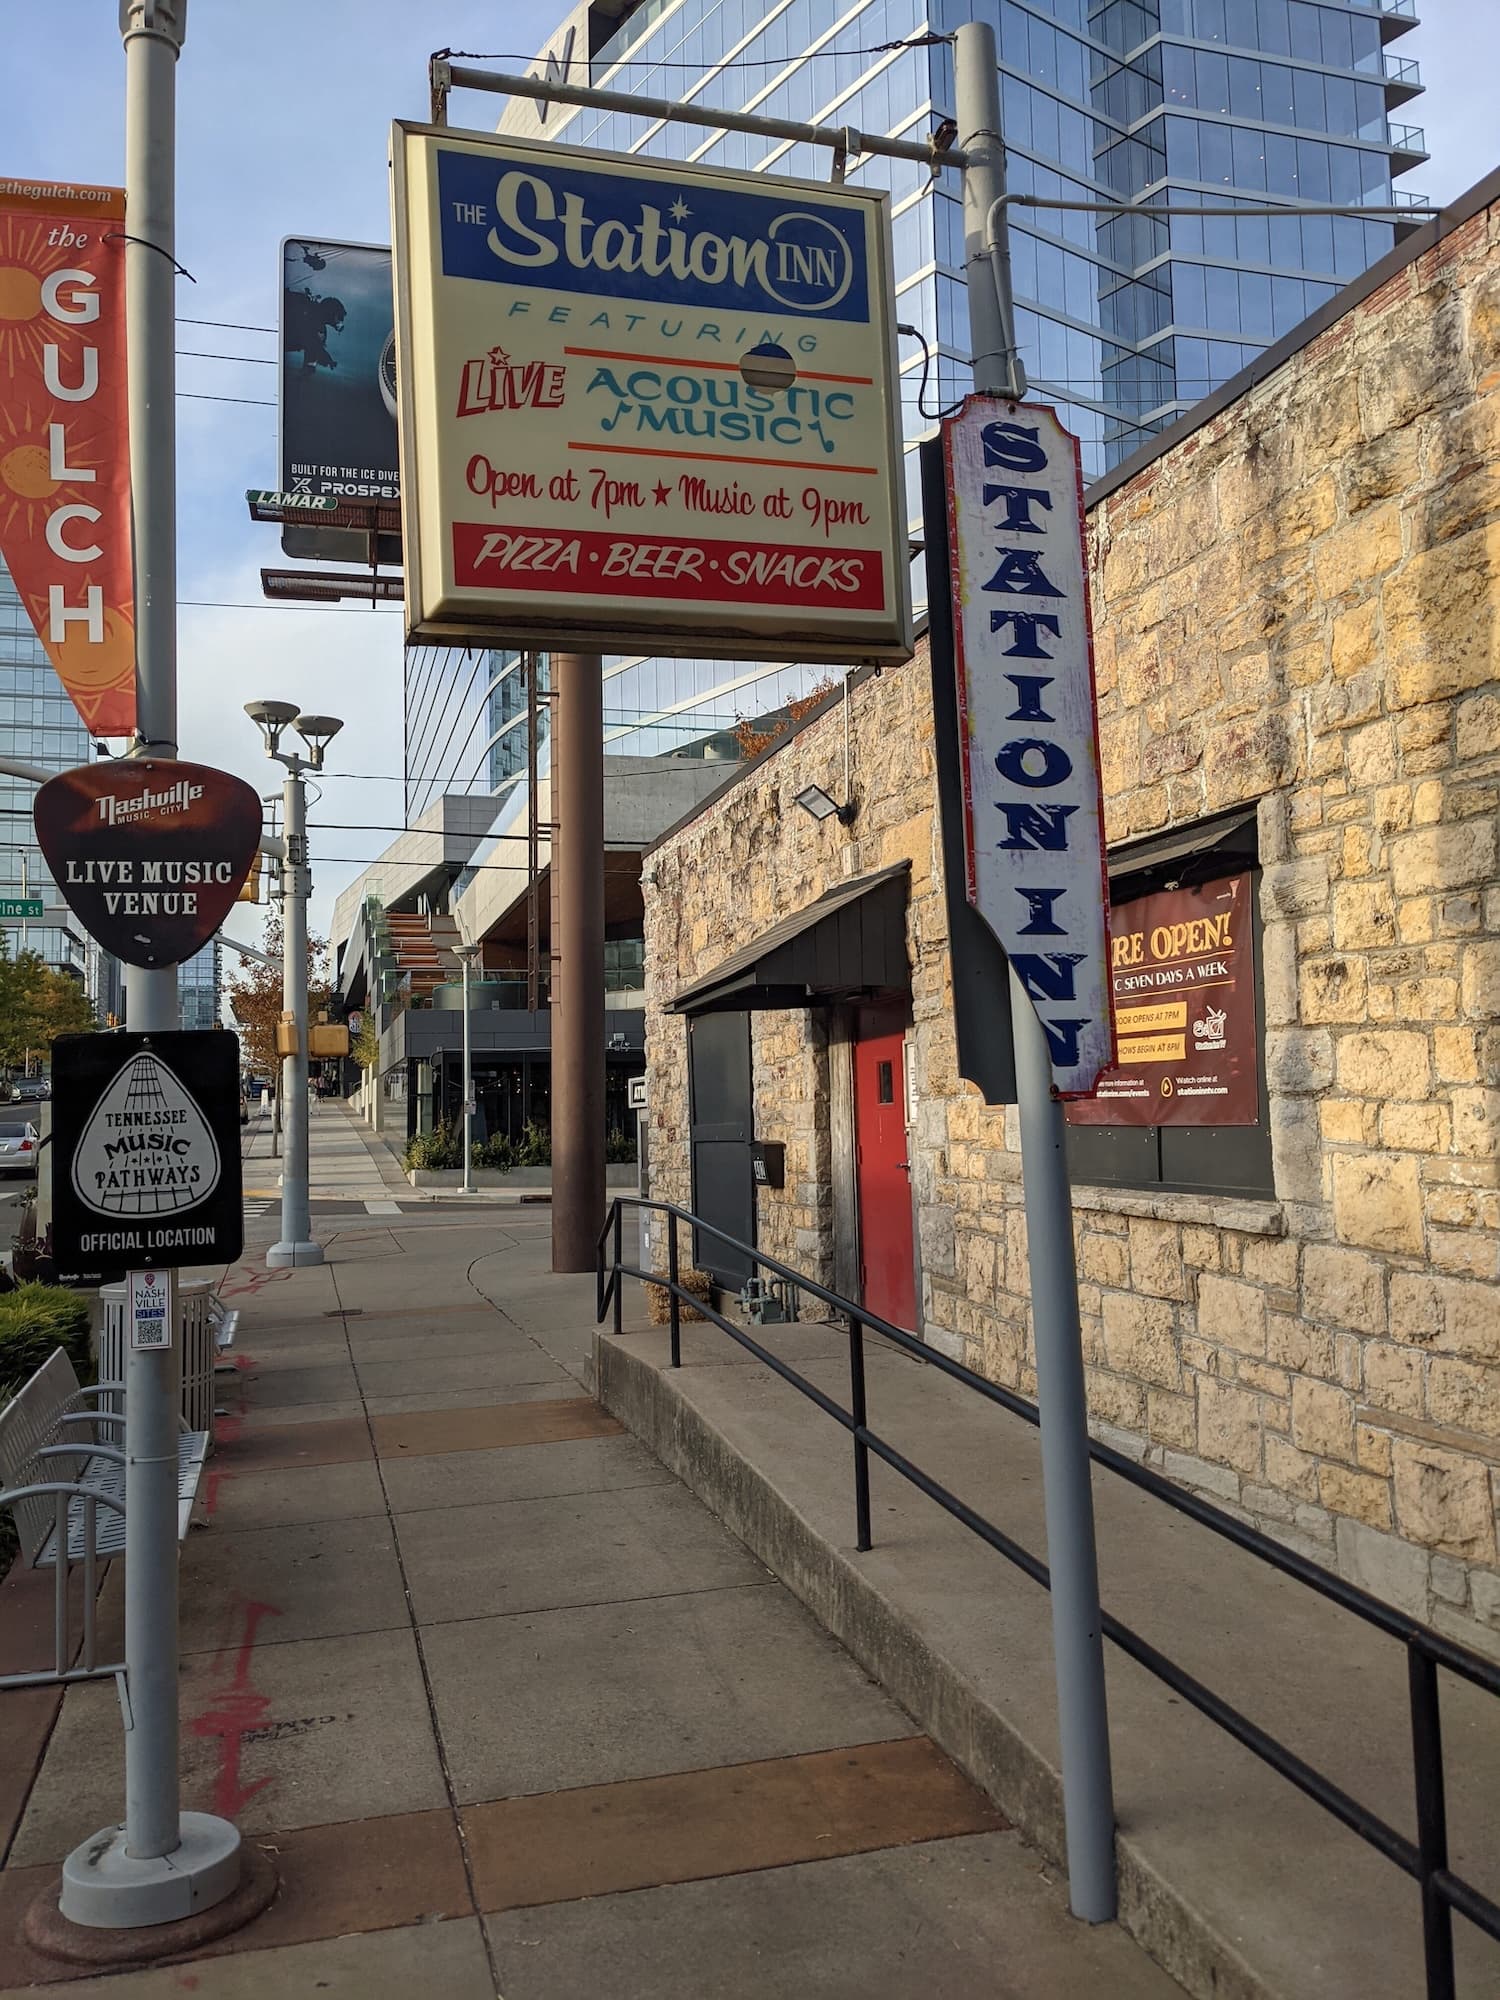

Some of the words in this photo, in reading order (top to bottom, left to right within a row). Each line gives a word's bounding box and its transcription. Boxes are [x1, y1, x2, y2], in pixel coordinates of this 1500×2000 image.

[48, 224, 88, 249] the
[452, 202, 487, 226] THE
[487, 171, 771, 288] Station
[775, 242, 838, 288] INN
[508, 301, 819, 354] FEATURING
[637, 405, 804, 445] MUSIC
[40, 268, 105, 645] GULCH
[291, 463, 317, 476] BUILT
[320, 465, 338, 477] FOR
[340, 467, 358, 479] THE
[361, 469, 375, 480] ICE
[257, 492, 327, 510] LAMAR
[466, 454, 544, 509] Open
[549, 469, 581, 502] at
[588, 469, 646, 519] 7pm
[679, 475, 756, 517] Music
[763, 487, 794, 520] at
[802, 487, 871, 538] 9pm
[473, 532, 582, 574] PIZZA
[601, 541, 703, 583] BEER
[720, 550, 864, 593] SNACKS
[979, 420, 1082, 852] STATION
[95, 780, 205, 826] Nashville
[117, 810, 151, 825] MUSIC
[160, 804, 183, 816] CITY
[66, 860, 133, 884] LIVE
[141, 860, 233, 884] MUSIC
[0, 901, 22, 916] ine
[103, 892, 198, 915] VENUE
[1150, 911, 1233, 960] OPEN!
[1124, 974, 1154, 990] SEVEN
[1156, 969, 1183, 985] DAYS
[1186, 969, 1195, 980] A
[1197, 960, 1229, 978] WEEK
[1132, 1013, 1154, 1024] OPENS
[1155, 1012, 1163, 1022] AT
[1164, 1010, 1180, 1020] 7PM
[1137, 1044, 1155, 1054] BEGIN
[1157, 1043, 1165, 1052] AT
[1175, 1076, 1196, 1084] Watch
[105, 1109, 188, 1127] TENNESSEE
[103, 1133, 192, 1160] MUSIC
[94, 1165, 200, 1189] PATHWAYS
[80, 1231, 144, 1252] OFFICIAL
[147, 1226, 216, 1248] LOCATION
[135, 1288, 166, 1299] NASH
[135, 1299, 166, 1309] VILLE
[136, 1309, 166, 1319] SITES
